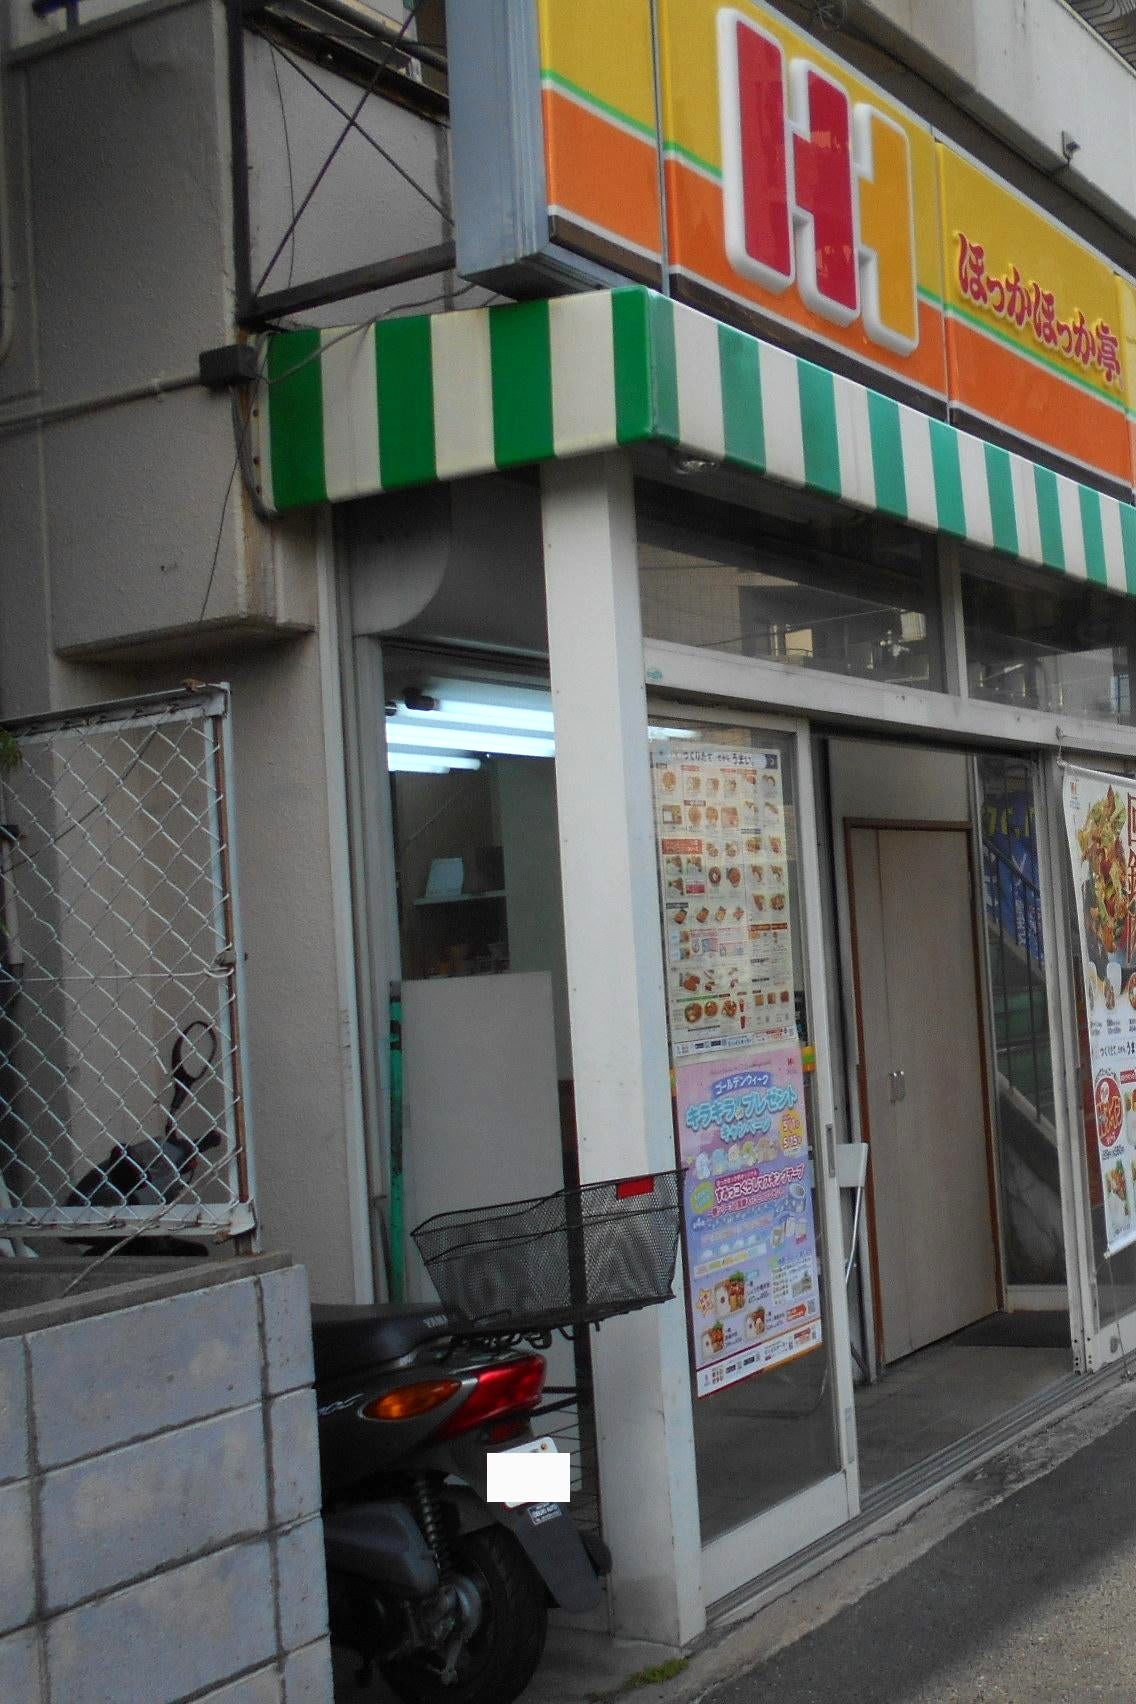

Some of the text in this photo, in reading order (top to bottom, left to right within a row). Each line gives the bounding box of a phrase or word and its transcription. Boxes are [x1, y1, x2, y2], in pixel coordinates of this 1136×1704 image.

[958, 231, 1122, 383] ほっかほっか亭
[715, 1074, 770, 1095] ゴールデンウィーク
